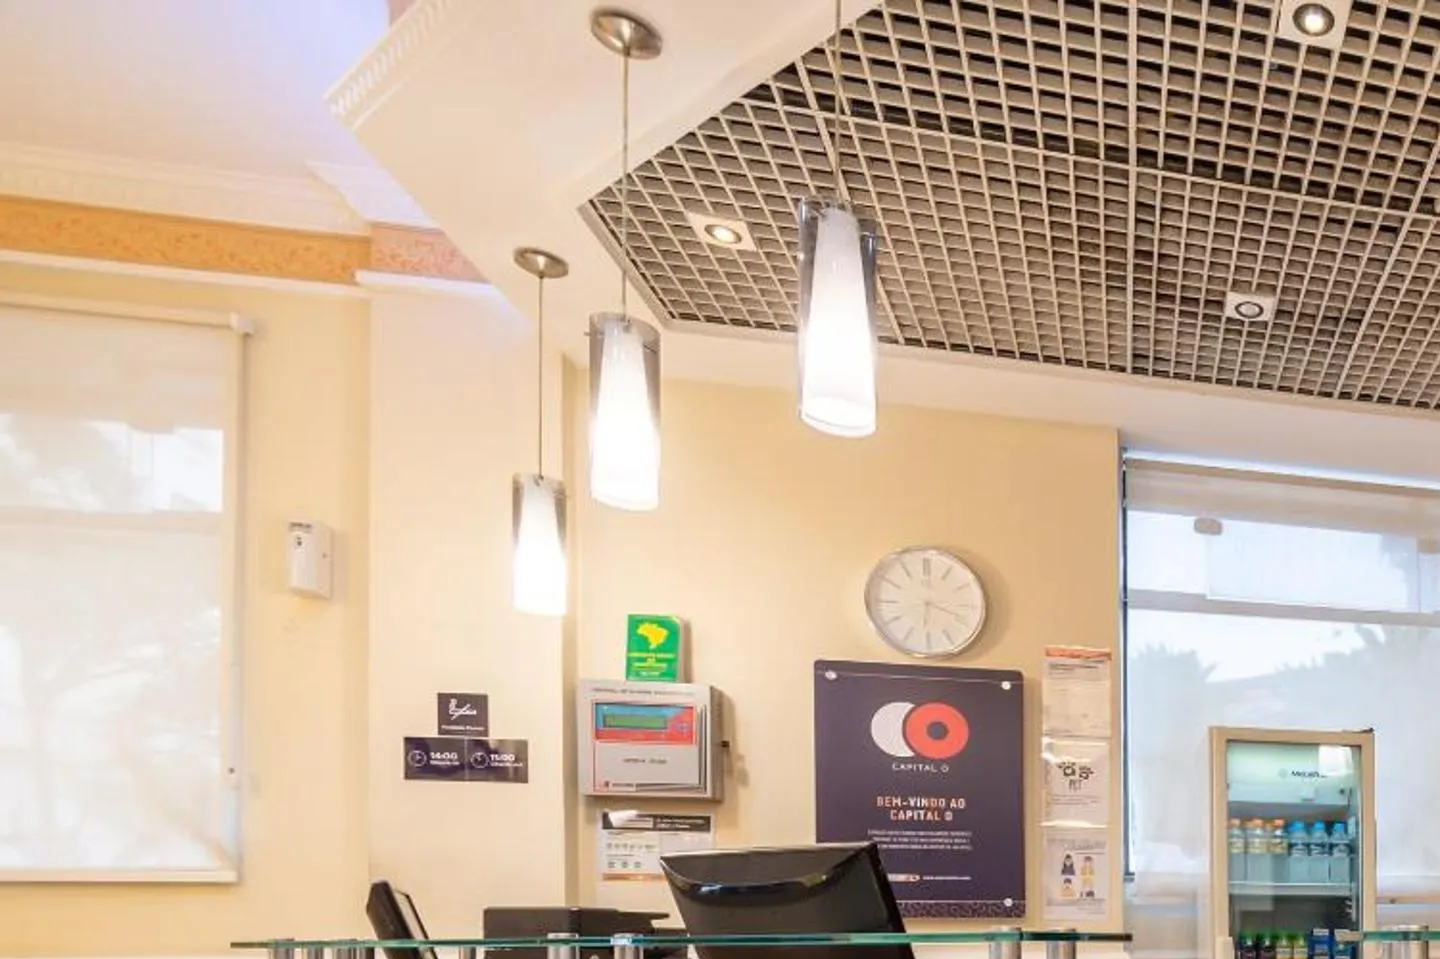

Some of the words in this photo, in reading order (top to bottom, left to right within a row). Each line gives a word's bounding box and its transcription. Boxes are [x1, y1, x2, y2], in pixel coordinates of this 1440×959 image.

[892, 762, 938, 773] CAPITAL
[940, 763, 950, 773] O
[876, 796, 946, 809] BEM-VINDO
[949, 798, 966, 809] AO
[890, 810, 941, 821] CAPITAL
